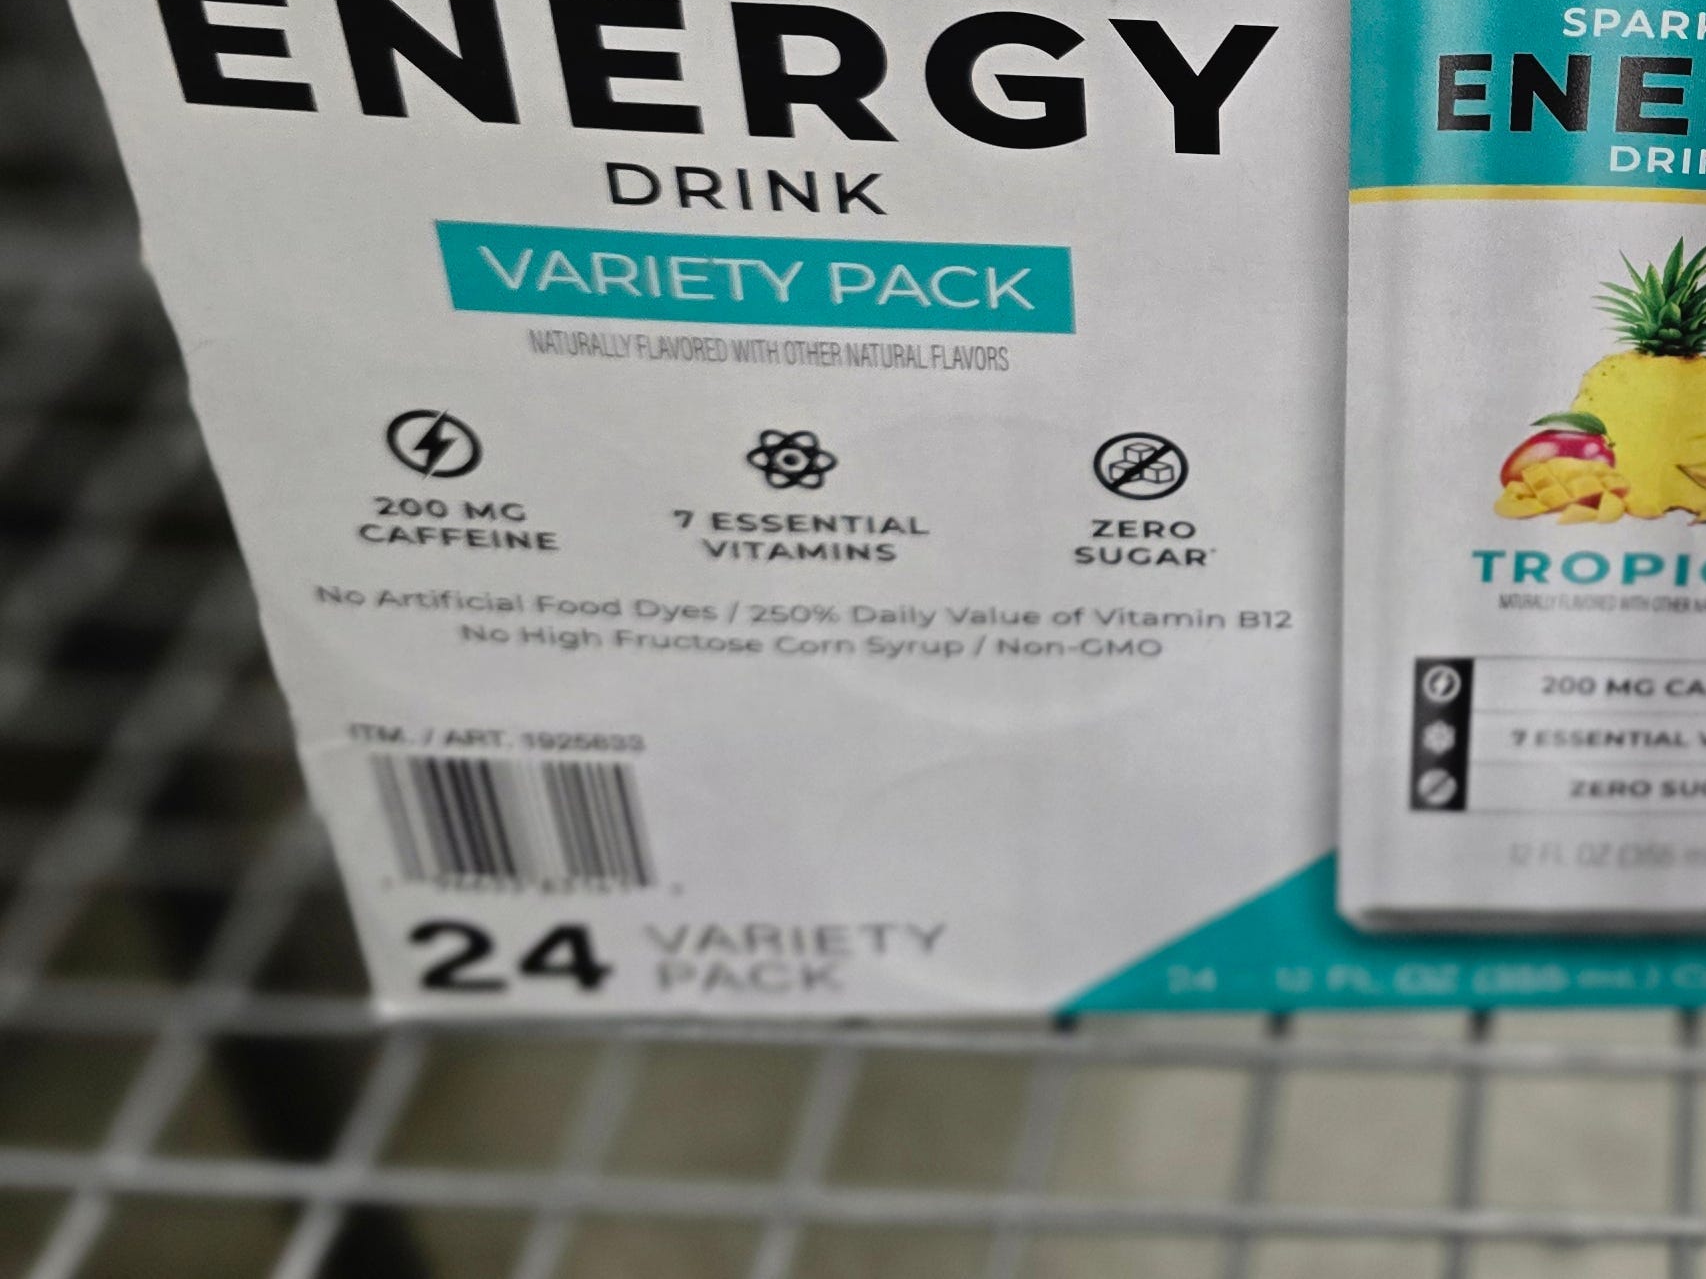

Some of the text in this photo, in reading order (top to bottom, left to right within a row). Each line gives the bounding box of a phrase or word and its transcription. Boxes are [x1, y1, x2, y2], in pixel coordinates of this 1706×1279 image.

[604, 162, 887, 215] DRINK
[479, 244, 1035, 311] VARIETY PACK
[527, 328, 1009, 371] NATURALLY FLAVORED WITH OTHER NATURAL FLAVORS
[374, 496, 526, 521] 200 MG
[673, 510, 930, 535] 7 ESSENTIAL
[1092, 519, 1196, 539] ZERO
[357, 523, 560, 550] CAFFEINE
[700, 539, 896, 562] VITAMINS
[315, 585, 365, 607] No
[378, 588, 524, 612] Artificial
[537, 593, 621, 616] Food
[634, 599, 717, 624] Dyes
[750, 603, 838, 624] 250%
[852, 605, 935, 629] Daily
[947, 607, 1040, 626] Value
[1052, 607, 1086, 626] of
[1094, 608, 1225, 628] Vitamin
[1238, 610, 1294, 629] B12
[460, 624, 510, 643] No
[521, 626, 602, 652] High
[614, 629, 763, 654] Fructose
[774, 635, 854, 654] Corn
[867, 636, 964, 660] Syrup
[998, 638, 1162, 657] Non-GMO
[1541, 677, 1596, 696] 200
[1606, 678, 1655, 697] MG
[1512, 729, 1526, 747] 7
[1535, 730, 1685, 748] ESSENTIAL
[1570, 779, 1650, 798] ZERO
[409, 918, 946, 993] 24 VARIETY
[656, 963, 844, 993] PACK
